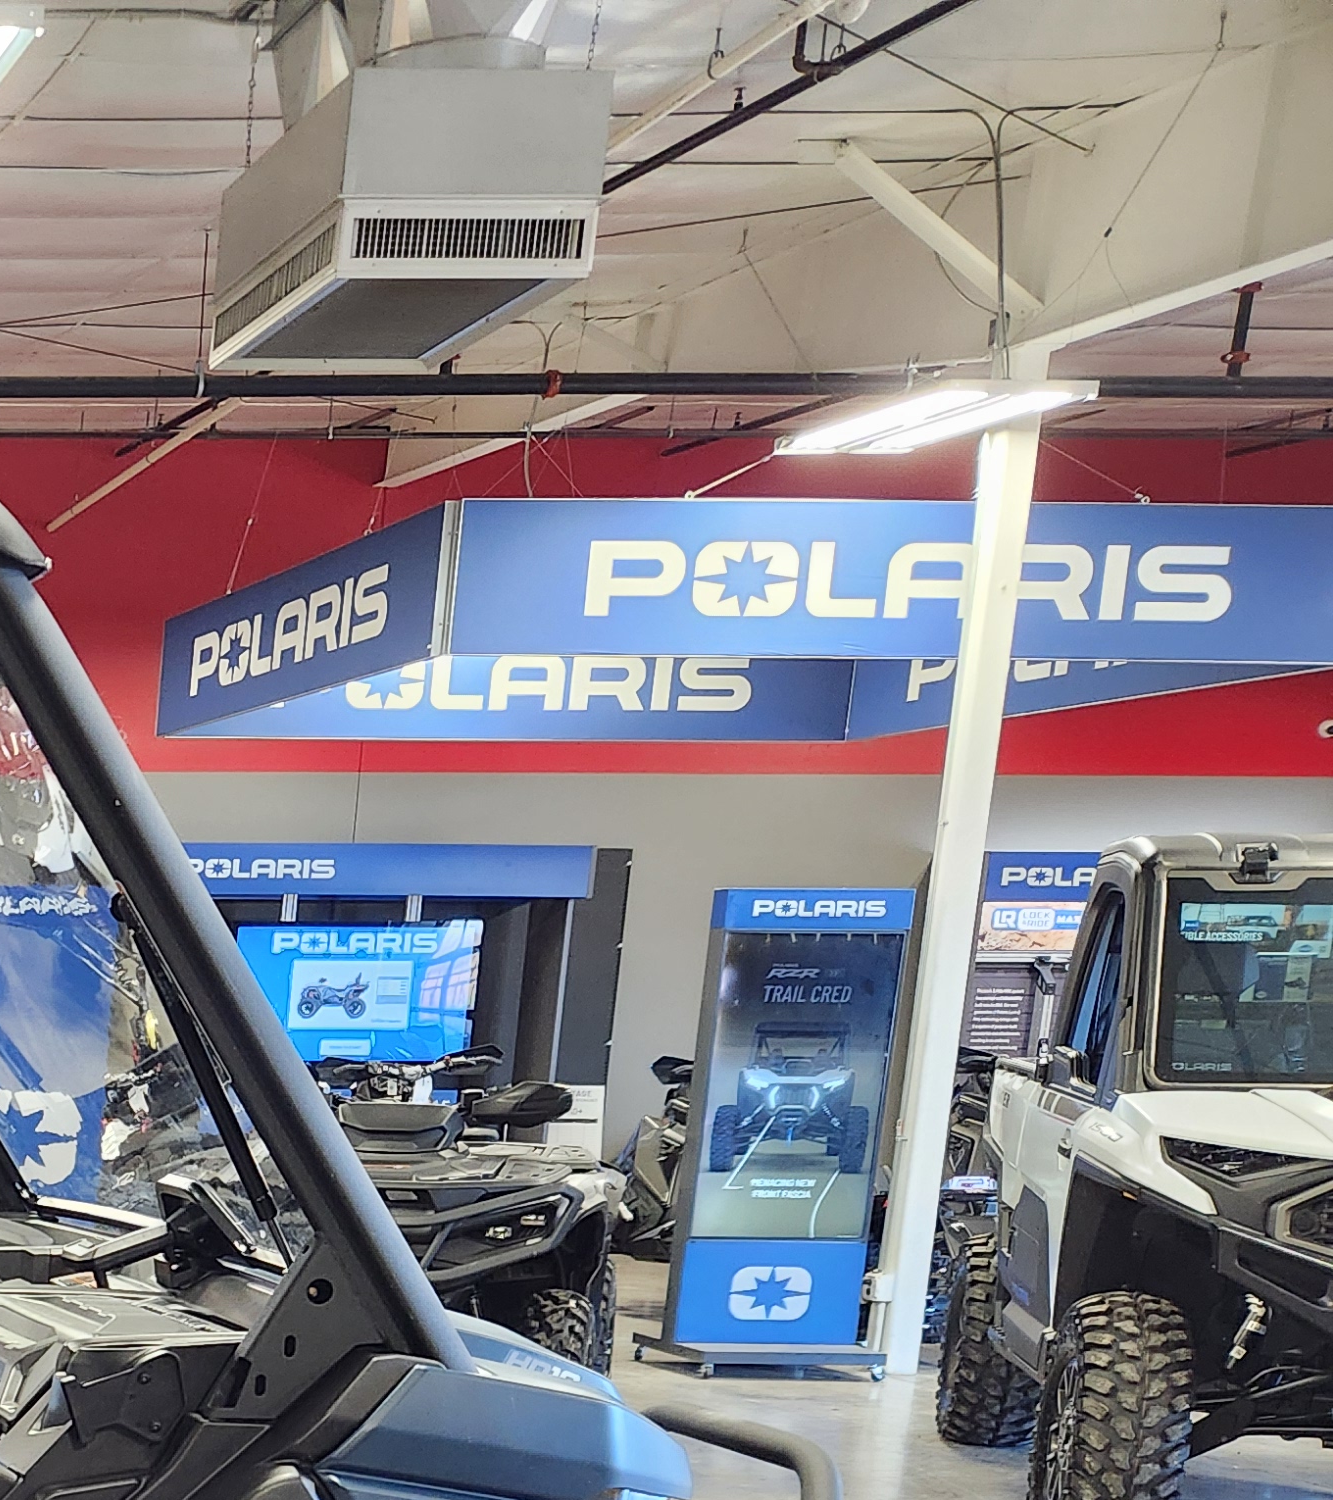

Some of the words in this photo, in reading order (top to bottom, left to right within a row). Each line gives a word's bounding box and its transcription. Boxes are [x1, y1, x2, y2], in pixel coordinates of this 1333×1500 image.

[584, 541, 1232, 622] POLARIS
[190, 563, 389, 697] POLARIS
[271, 656, 752, 711] OLARIS
[189, 858, 336, 879] POLARIS
[1000, 867, 1097, 887] POLA
[752, 899, 887, 918] POLARIS
[271, 932, 438, 955] POLARIS
[766, 968, 821, 979] RZR
[764, 985, 806, 1003] TRAIL
[810, 985, 853, 1003] CRED
